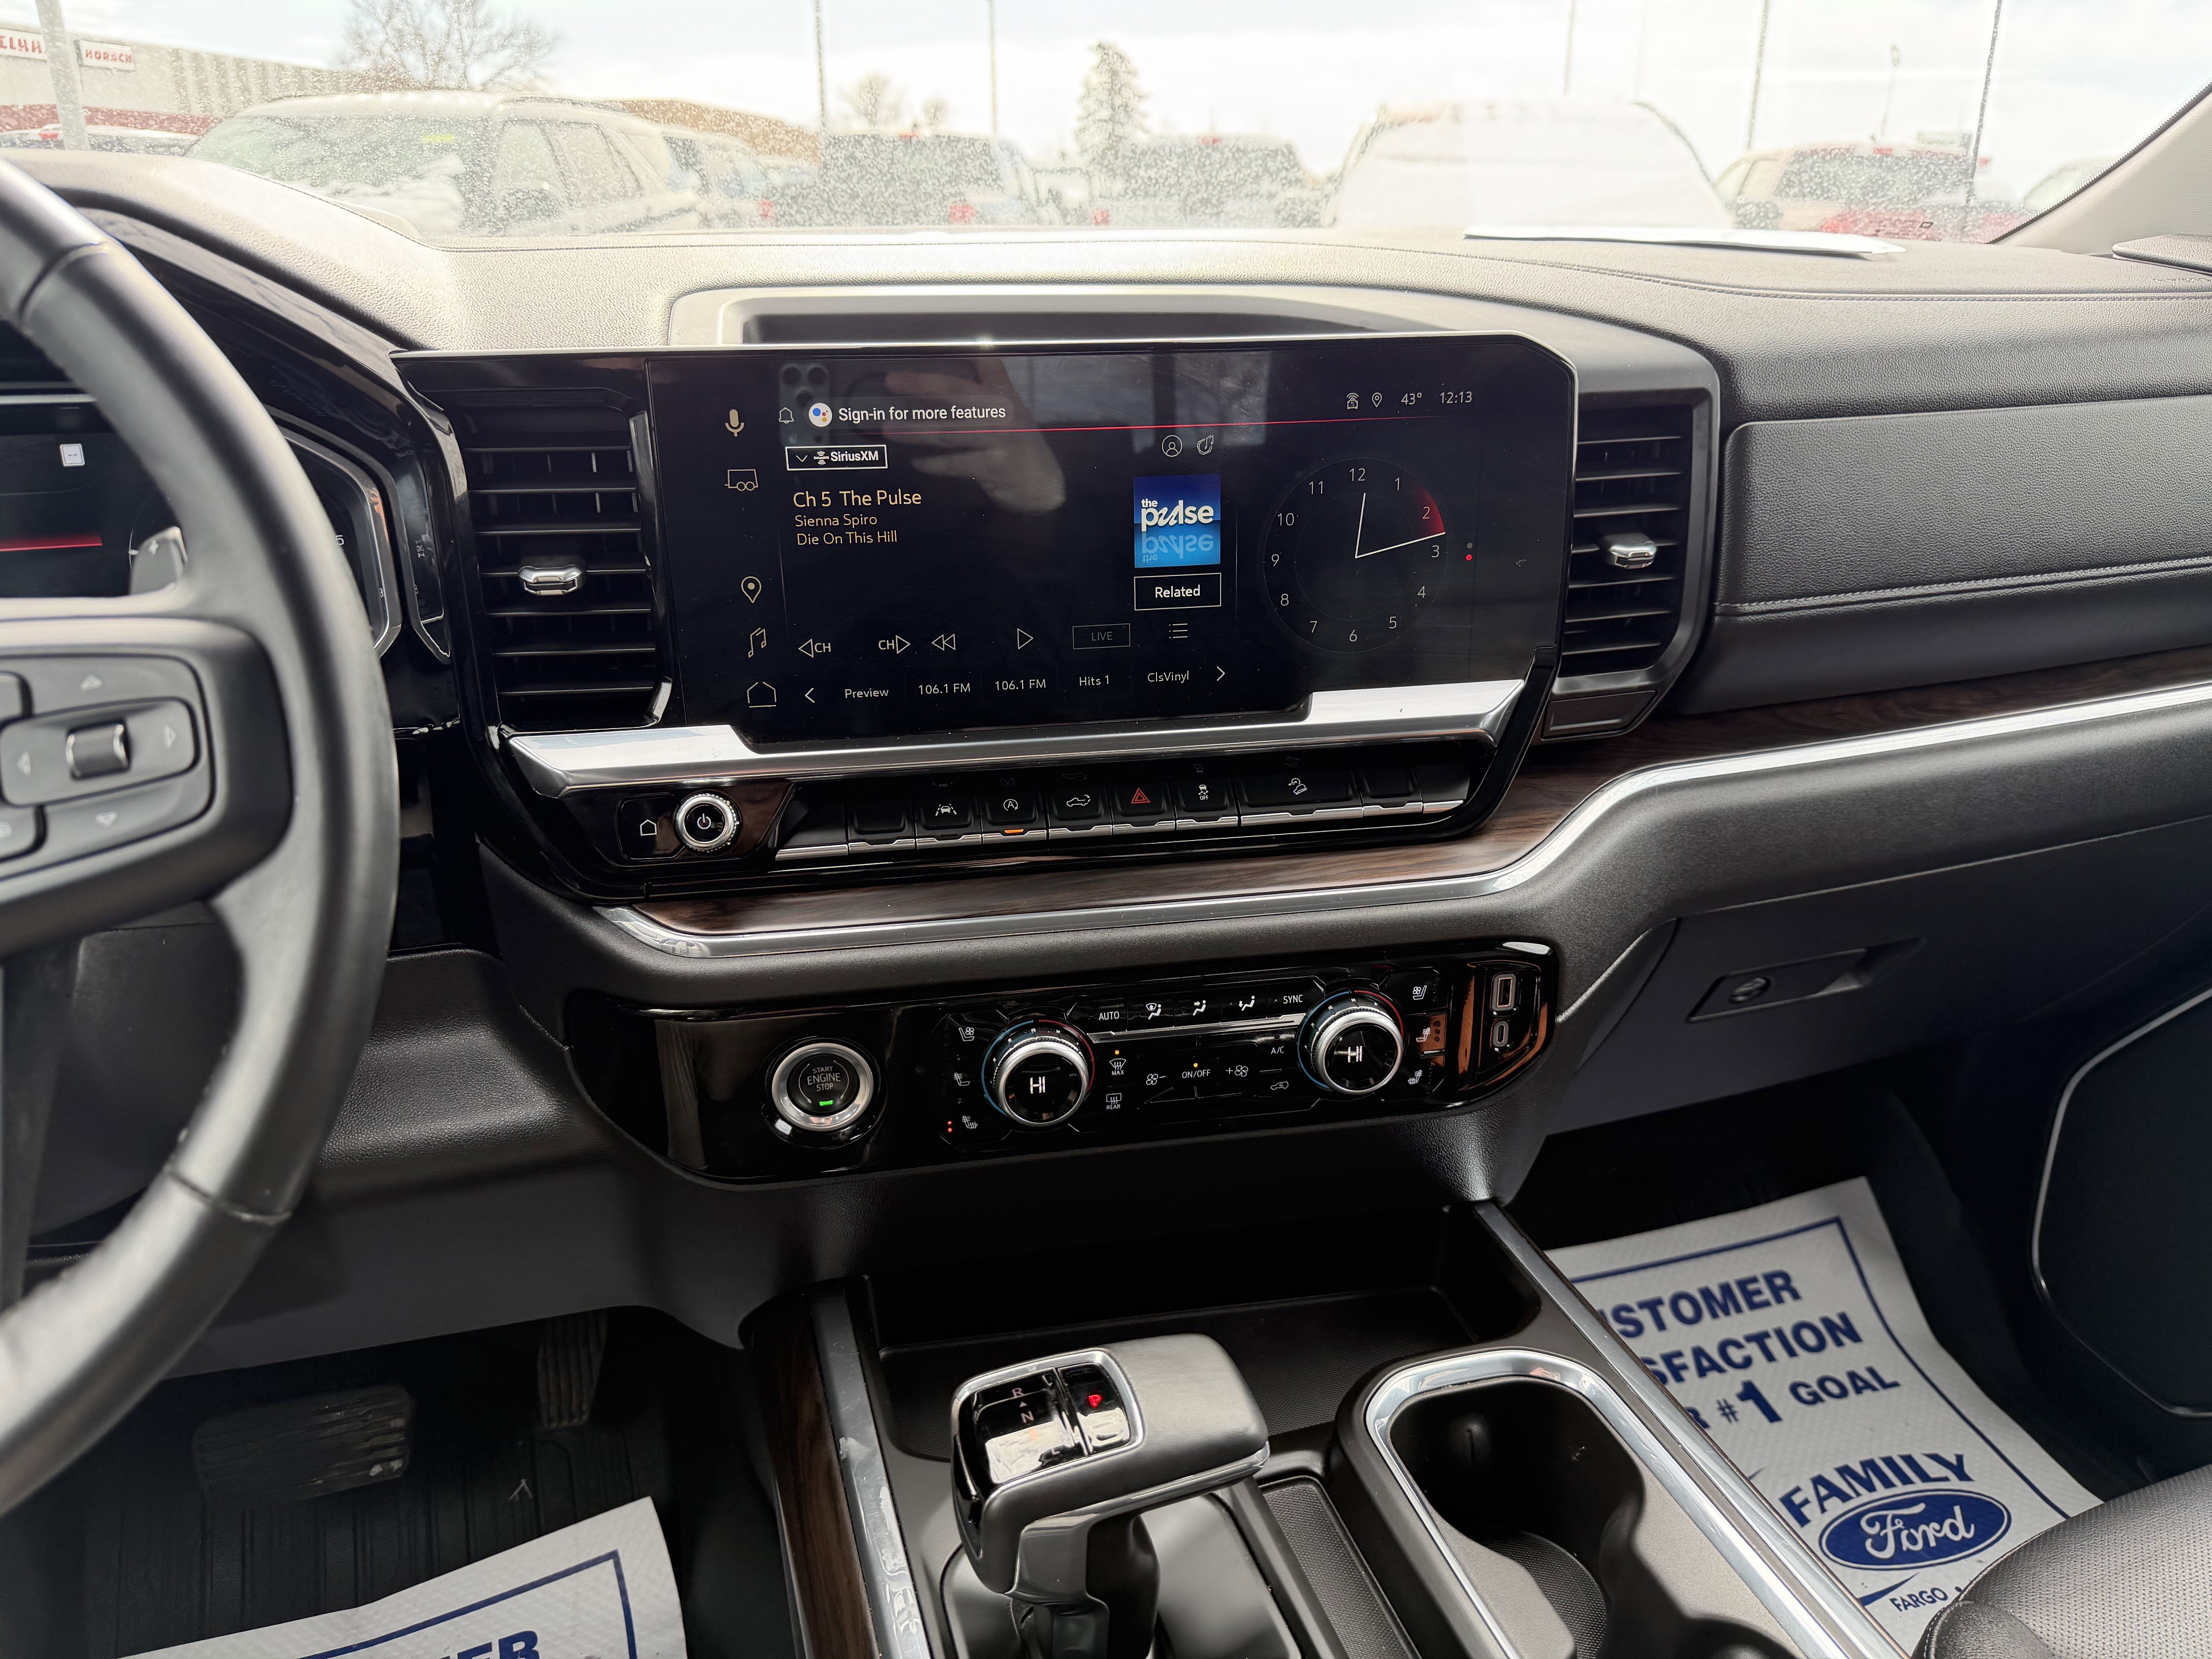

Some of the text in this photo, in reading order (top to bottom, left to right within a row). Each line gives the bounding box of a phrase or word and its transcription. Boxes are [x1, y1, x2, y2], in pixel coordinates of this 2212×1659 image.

[1440, 391, 1472, 404] 12:13
[839, 405, 1006, 424] Sign-in for more features
[830, 450, 879, 462] SiriusXM
[1349, 468, 1366, 482] 12
[1309, 481, 1324, 495] 11
[1395, 477, 1400, 491] 1
[793, 489, 922, 507] Ch 5 The Pulse
[1141, 498, 1158, 507] the
[1141, 500, 1214, 532] pulse
[1422, 507, 1431, 519] 2
[795, 513, 877, 529] Sienna Spiro
[1278, 513, 1295, 527] 10
[797, 530, 898, 545] Die On This Hill
[1431, 545, 1440, 558] 3
[1271, 554, 1279, 567] 9
[1155, 584, 1200, 598] Related
[1417, 586, 1427, 598] 4
[1280, 593, 1289, 606] 8
[1310, 621, 1317, 633] 7
[1388, 616, 1398, 629] 5
[1091, 632, 1113, 641] LIVE
[1349, 629, 1357, 642] 6
[814, 642, 831, 653] CH
[878, 640, 895, 650] CH
[1079, 675, 1109, 686] Hits 1
[1147, 670, 1189, 683] ClsVinyl
[919, 683, 970, 694] 106.1 FM
[995, 679, 1046, 691] 106.1 FM
[845, 688, 889, 699] Preview
[1283, 995, 1303, 1004] SYNC
[1099, 1012, 1120, 1021] AUTO
[1271, 1046, 1285, 1054] A/C
[807, 1073, 841, 1086] ENGINE
[1182, 1069, 1211, 1079] ON/OFF
[816, 1083, 833, 1091] STOP
[1597, 1269, 1802, 1338] STOMER
[1011, 1388, 1025, 1397] R
[1788, 1366, 1901, 1406] GOAL
[1088, 1395, 1103, 1408] P
[1021, 1411, 1035, 1423] N
[1778, 1453, 1975, 1528] FAMILY
[1860, 1502, 1975, 1559] Ford
[1889, 1587, 1948, 1613] FARGO
